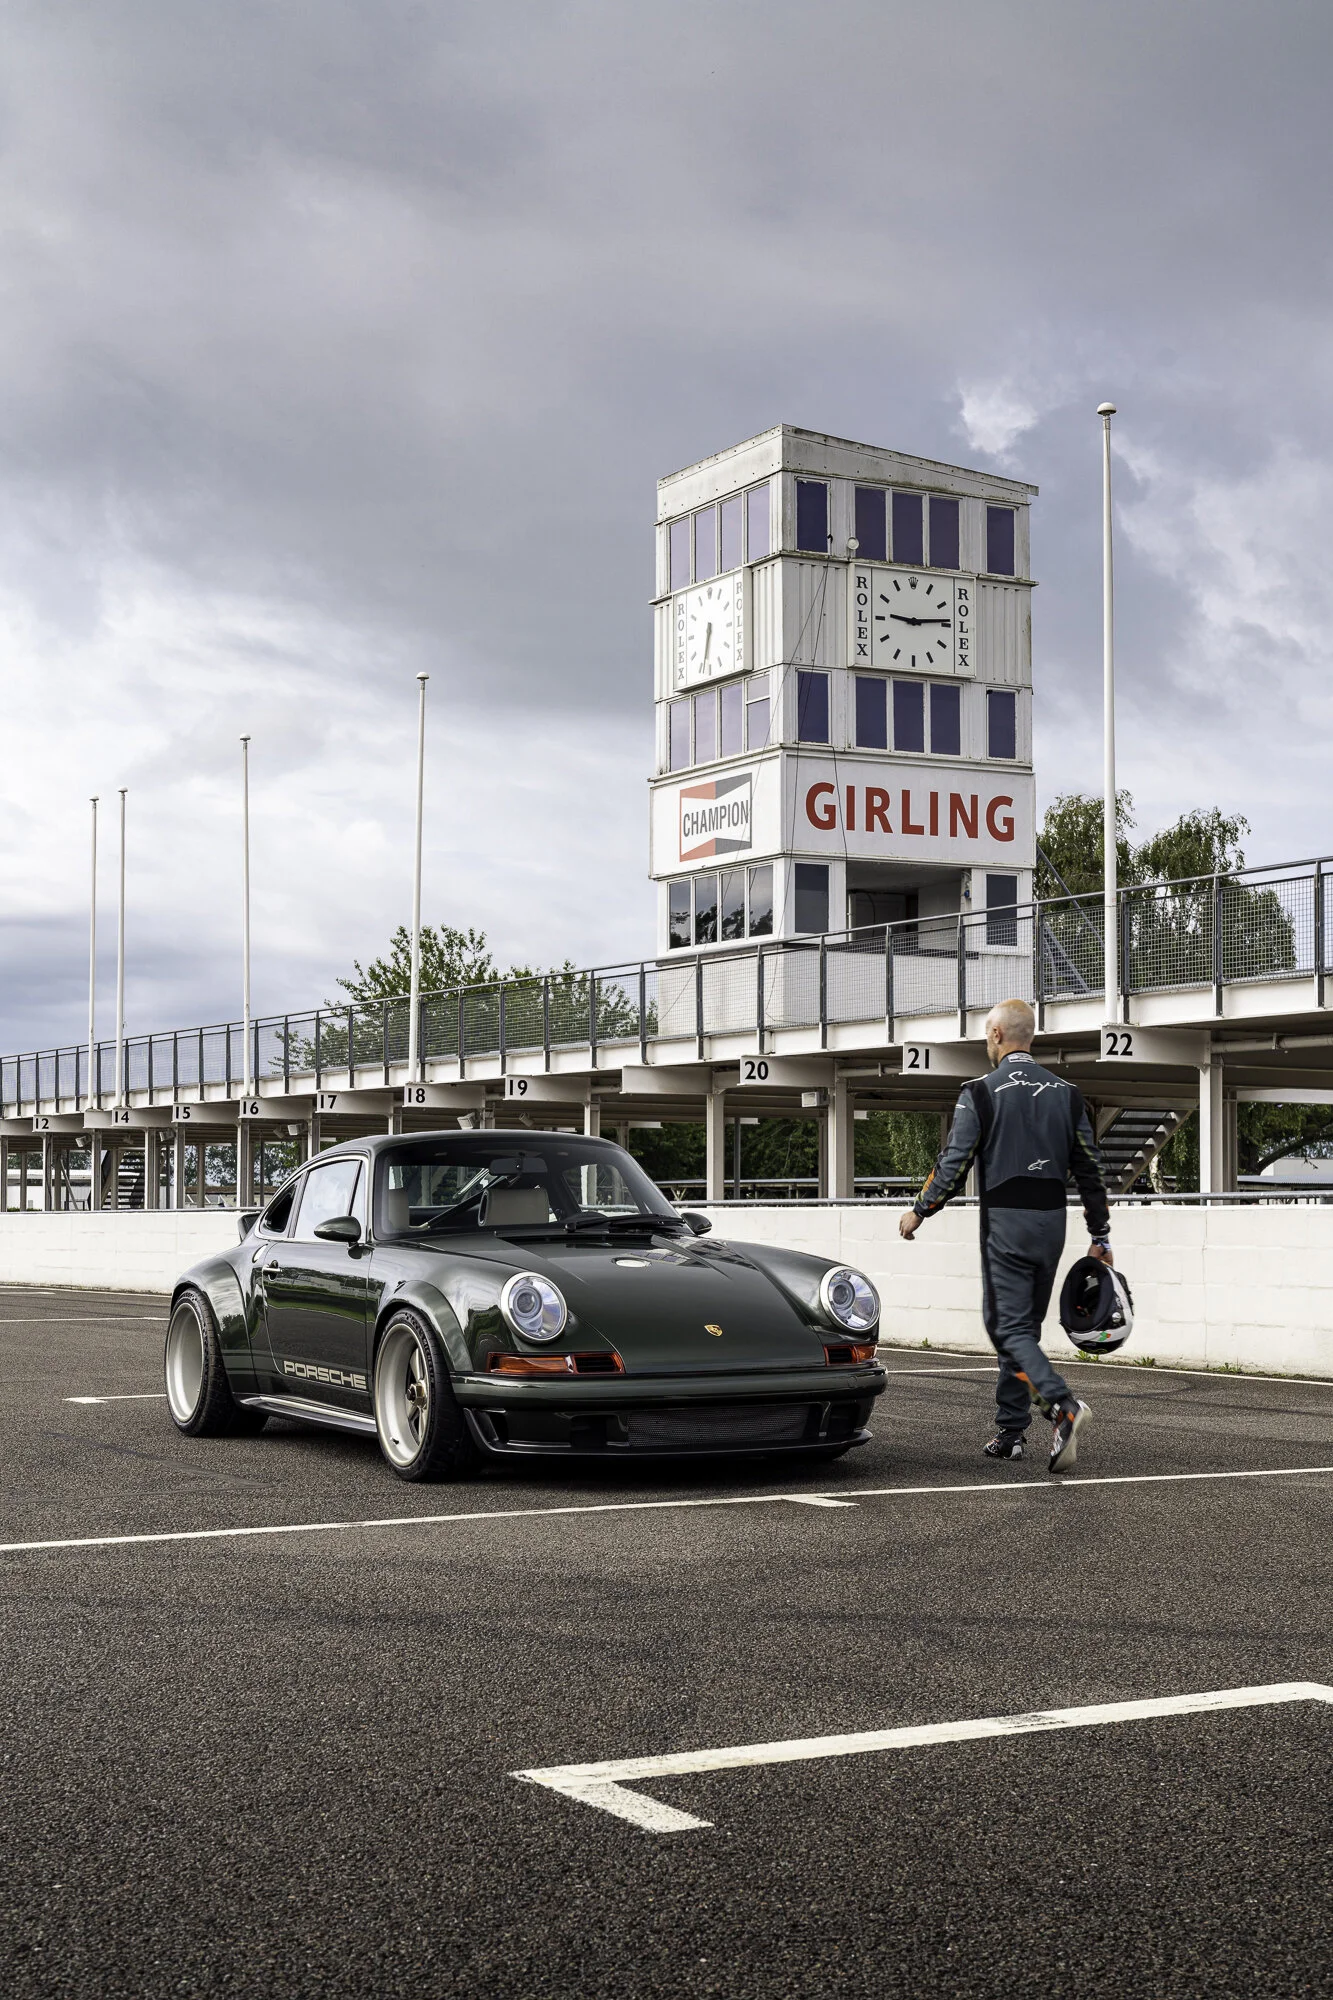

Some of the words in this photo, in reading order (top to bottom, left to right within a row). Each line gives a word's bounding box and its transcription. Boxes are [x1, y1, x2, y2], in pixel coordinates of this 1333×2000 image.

[735, 581, 743, 661] ROLEX
[855, 575, 868, 657] ROLEX
[957, 587, 970, 668] ROLEX
[677, 603, 685, 680] ROLEX
[683, 799, 749, 838] CHAMPION
[805, 782, 1015, 842] GIRLING
[1105, 1033, 1133, 1056] 22
[907, 1048, 930, 1070] 21
[744, 1061, 769, 1080] 20
[406, 1087, 426, 1104] 18
[508, 1079, 528, 1096] 19
[175, 1106, 191, 1119] 15
[243, 1101, 259, 1116] 16
[318, 1094, 338, 1110] 17
[35, 1118, 50, 1130] 12
[114, 1111, 130, 1123] 14
[283, 1361, 367, 1389] PORSCHE
